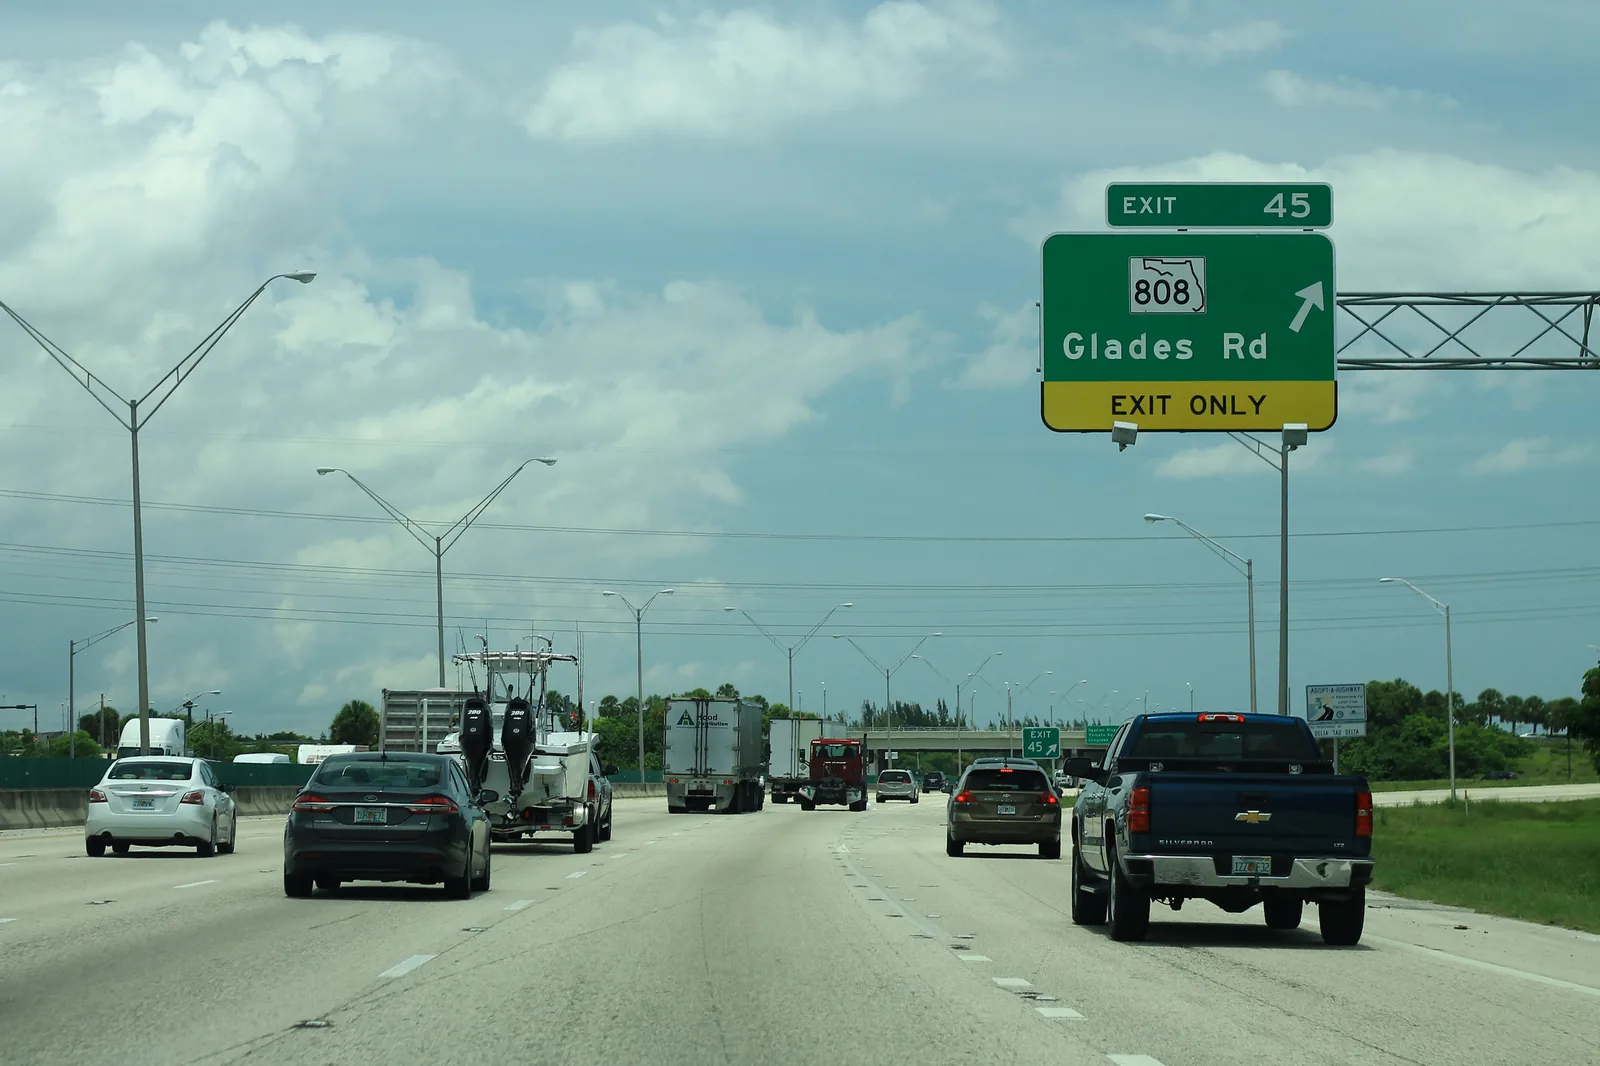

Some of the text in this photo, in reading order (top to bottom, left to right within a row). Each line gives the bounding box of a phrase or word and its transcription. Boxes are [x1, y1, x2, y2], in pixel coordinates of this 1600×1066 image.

[1123, 193, 1311, 218] EXIT 45
[1134, 279, 1190, 305] 808
[1063, 332, 1267, 360] Glades Rd
[1111, 395, 1267, 415] EXIT ONLY
[1030, 730, 1052, 739] EXIT
[1027, 741, 1043, 752] 45
